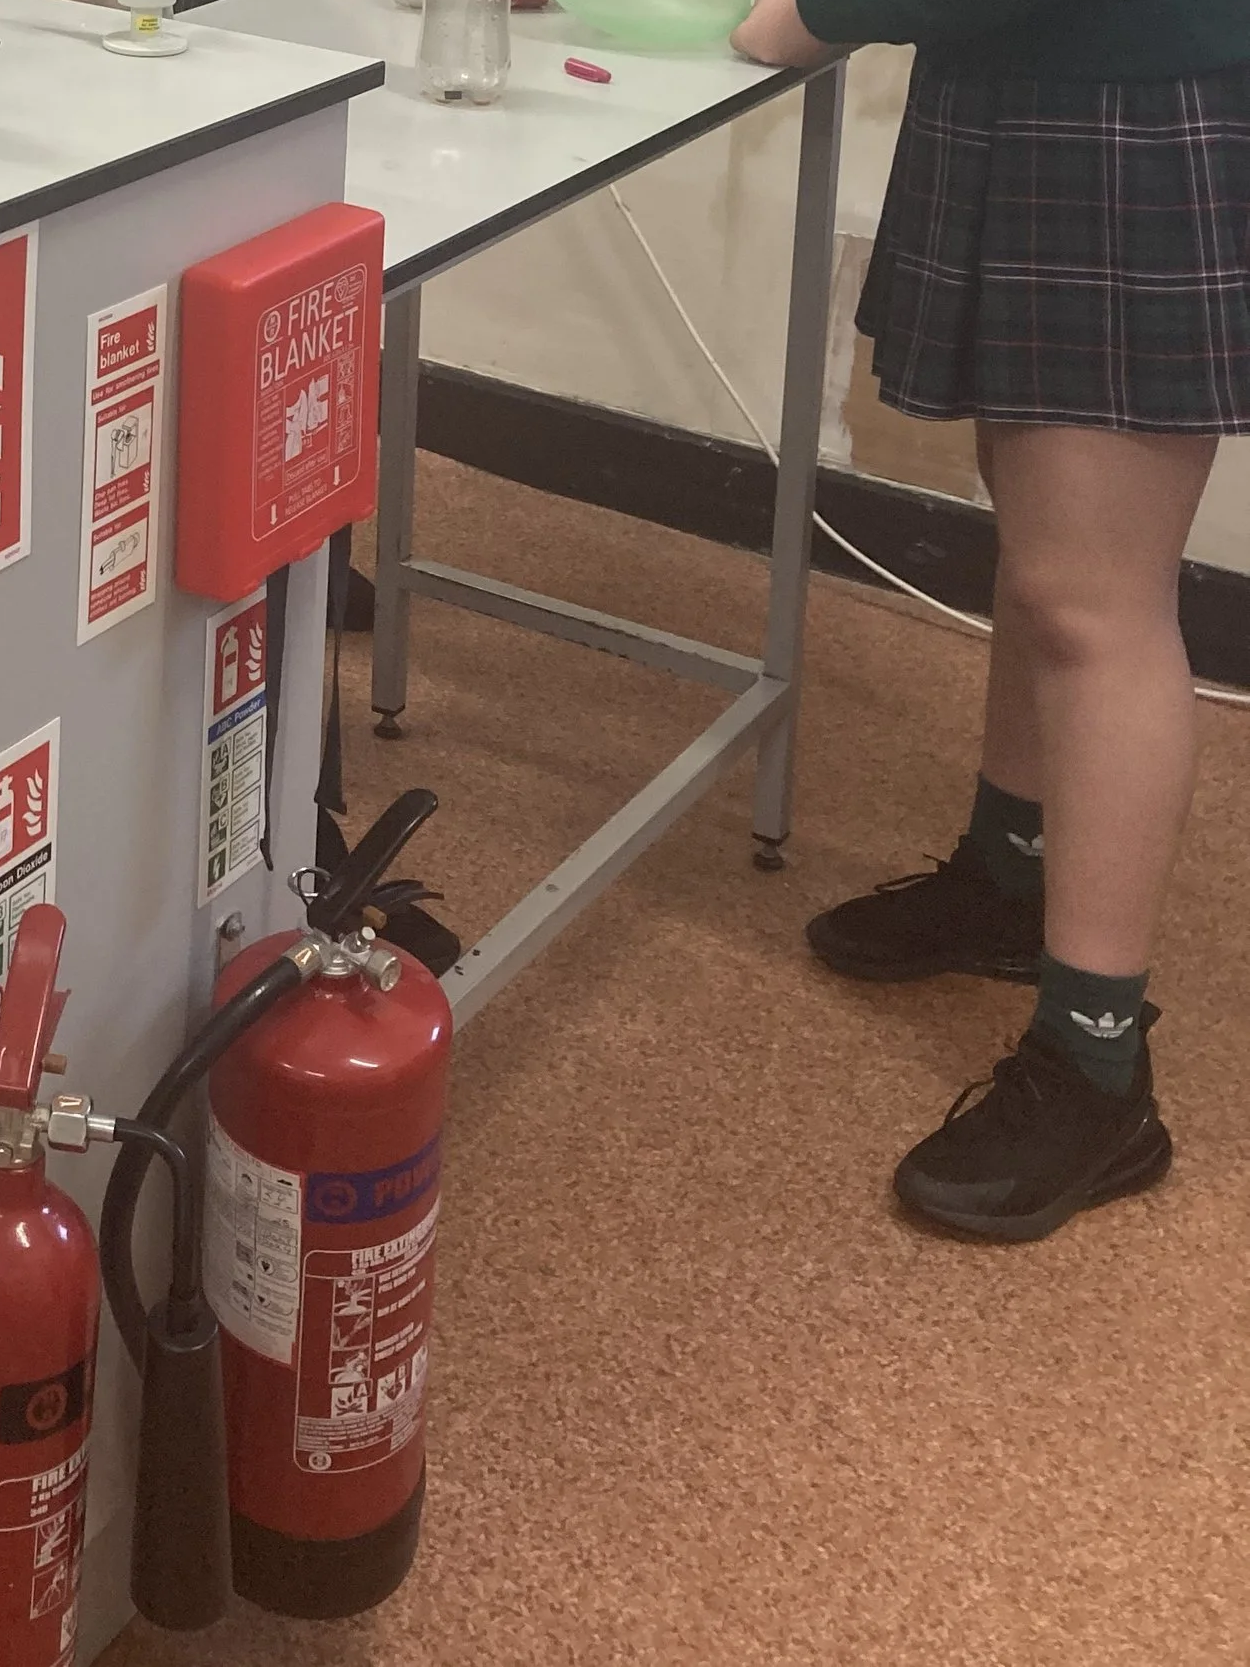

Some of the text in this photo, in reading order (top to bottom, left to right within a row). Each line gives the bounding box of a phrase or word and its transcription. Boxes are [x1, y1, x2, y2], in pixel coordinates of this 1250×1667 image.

[288, 281, 334, 336] FIRE
[100, 331, 121, 351] Fire
[100, 338, 140, 370] blanket
[260, 305, 359, 391] BLANKET
[216, 699, 261, 735] ABC Powder
[221, 743, 229, 757] A
[221, 779, 227, 792] B
[219, 813, 227, 827] C
[16, 851, 48, 879] Dioxide
[357, 1384, 368, 1399] A
[32, 1464, 66, 1493] FIRE
